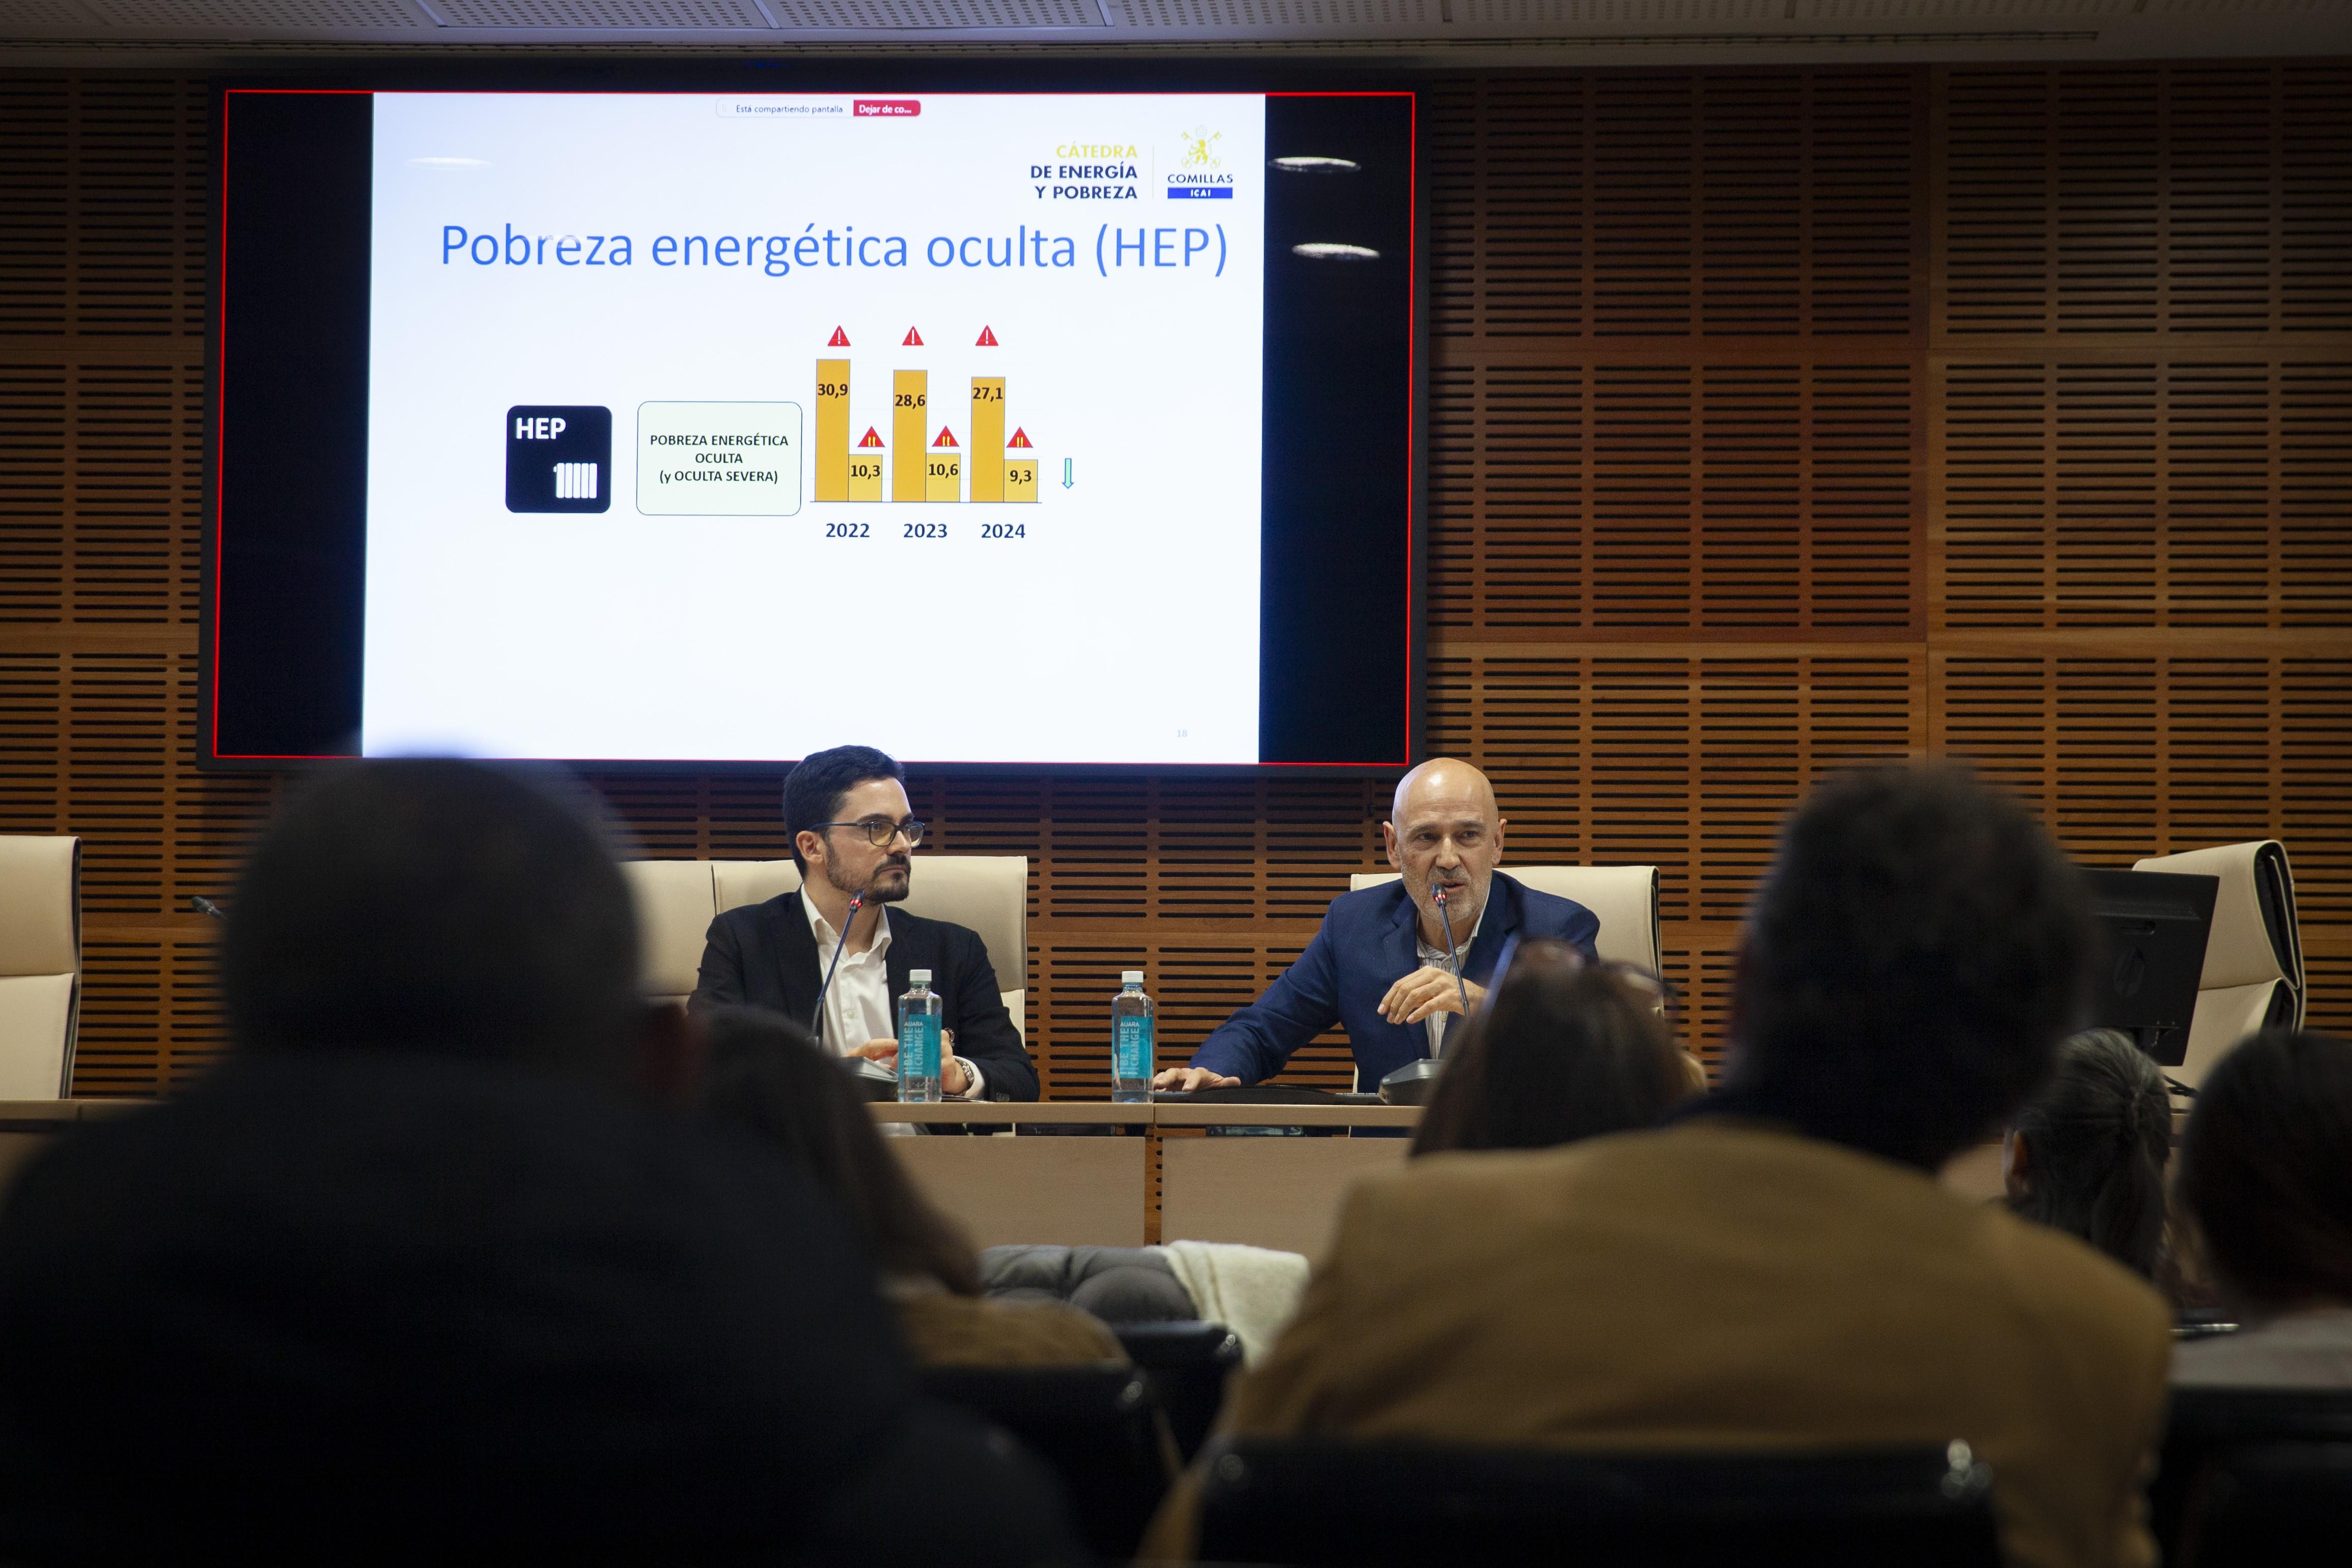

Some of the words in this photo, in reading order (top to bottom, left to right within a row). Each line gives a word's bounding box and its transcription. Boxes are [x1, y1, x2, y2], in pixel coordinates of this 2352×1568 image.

[737, 104, 751, 113] Está
[754, 106, 809, 114] compartiendo
[812, 106, 842, 114] pantalla
[859, 105, 881, 115] Dejar
[882, 105, 893, 113] de
[1056, 142, 1138, 158] CÁTEDRA
[1031, 166, 1051, 178] DE
[1060, 162, 1137, 179] ENERGÍA
[1168, 174, 1232, 183] COMILLAS
[1035, 186, 1046, 198] Y
[1053, 186, 1137, 199] POBREZA
[1190, 189, 1211, 197] ICAI
[443, 223, 631, 265] Pobreza
[653, 223, 906, 277] energética
[927, 225, 1074, 267] oculta
[1097, 224, 1226, 277] (HEP)
[818, 384, 847, 398] 30,9
[972, 388, 1003, 402] 27,1
[895, 395, 926, 408] 28,6
[516, 418, 566, 439] HEP
[651, 435, 707, 445] POBREZA
[712, 433, 788, 446] ENERGÉTICA
[695, 454, 743, 463] OCULTA
[660, 470, 671, 484] (y
[675, 471, 722, 481] OCULTA
[726, 471, 777, 484] SEVERA)
[851, 465, 880, 480] 10,3
[929, 464, 958, 478] 10,6
[1010, 470, 1031, 485] 9,3
[826, 523, 870, 538] 2022
[904, 524, 947, 538] 2023
[982, 524, 1025, 538] 2024
[904, 1027, 913, 1047] THE
[1120, 1028, 1129, 1047] THE
[915, 1027, 923, 1066] CHANGE
[1130, 1028, 1139, 1067] CHANGE
[904, 1052, 913, 1066] BE
[1120, 1052, 1129, 1066] BE
